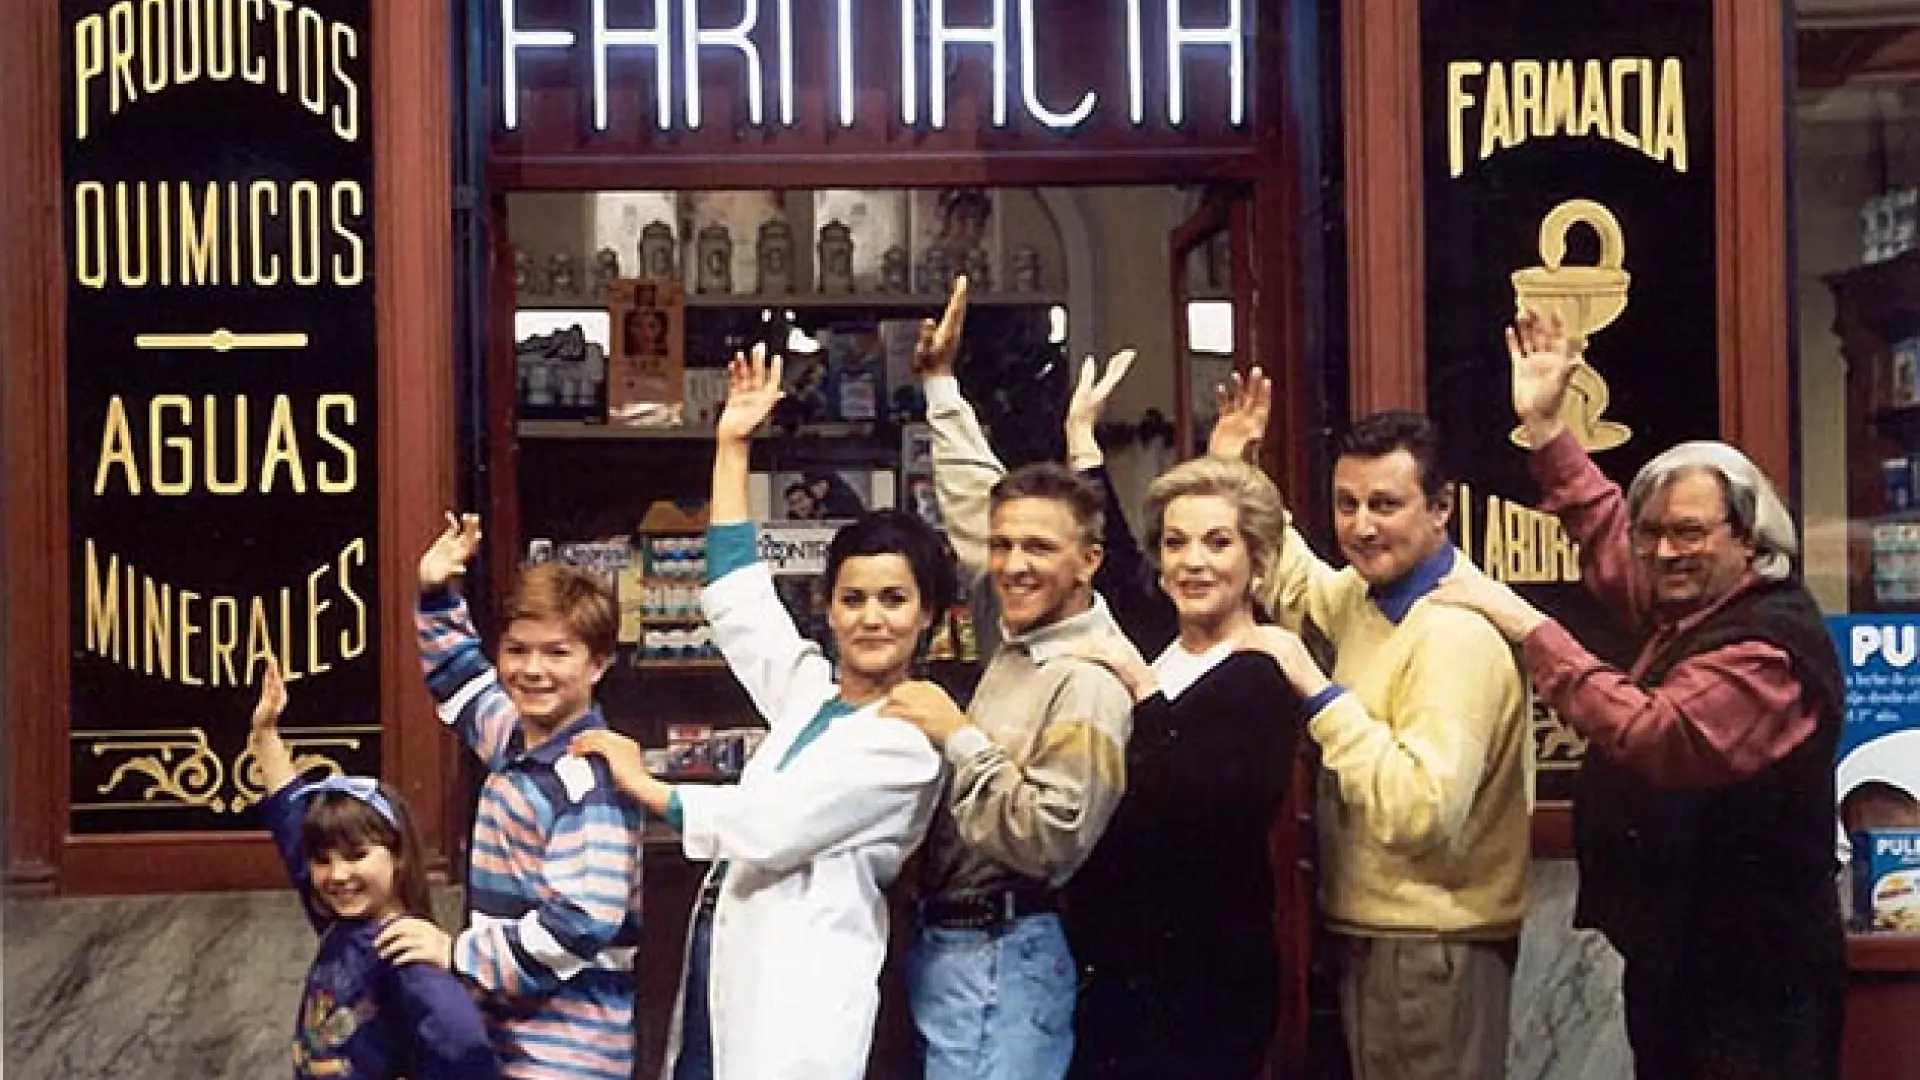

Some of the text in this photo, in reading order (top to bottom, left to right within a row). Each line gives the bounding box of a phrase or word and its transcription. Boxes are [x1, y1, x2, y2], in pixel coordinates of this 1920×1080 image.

[75, 0, 358, 141] PRODUCTOS
[502, 0, 1243, 129] FARMACIA
[1447, 57, 1689, 178] FARMACIA
[75, 180, 364, 288] QUIMICOS
[94, 394, 357, 495] AGUAS
[85, 537, 367, 688] MINERALES
